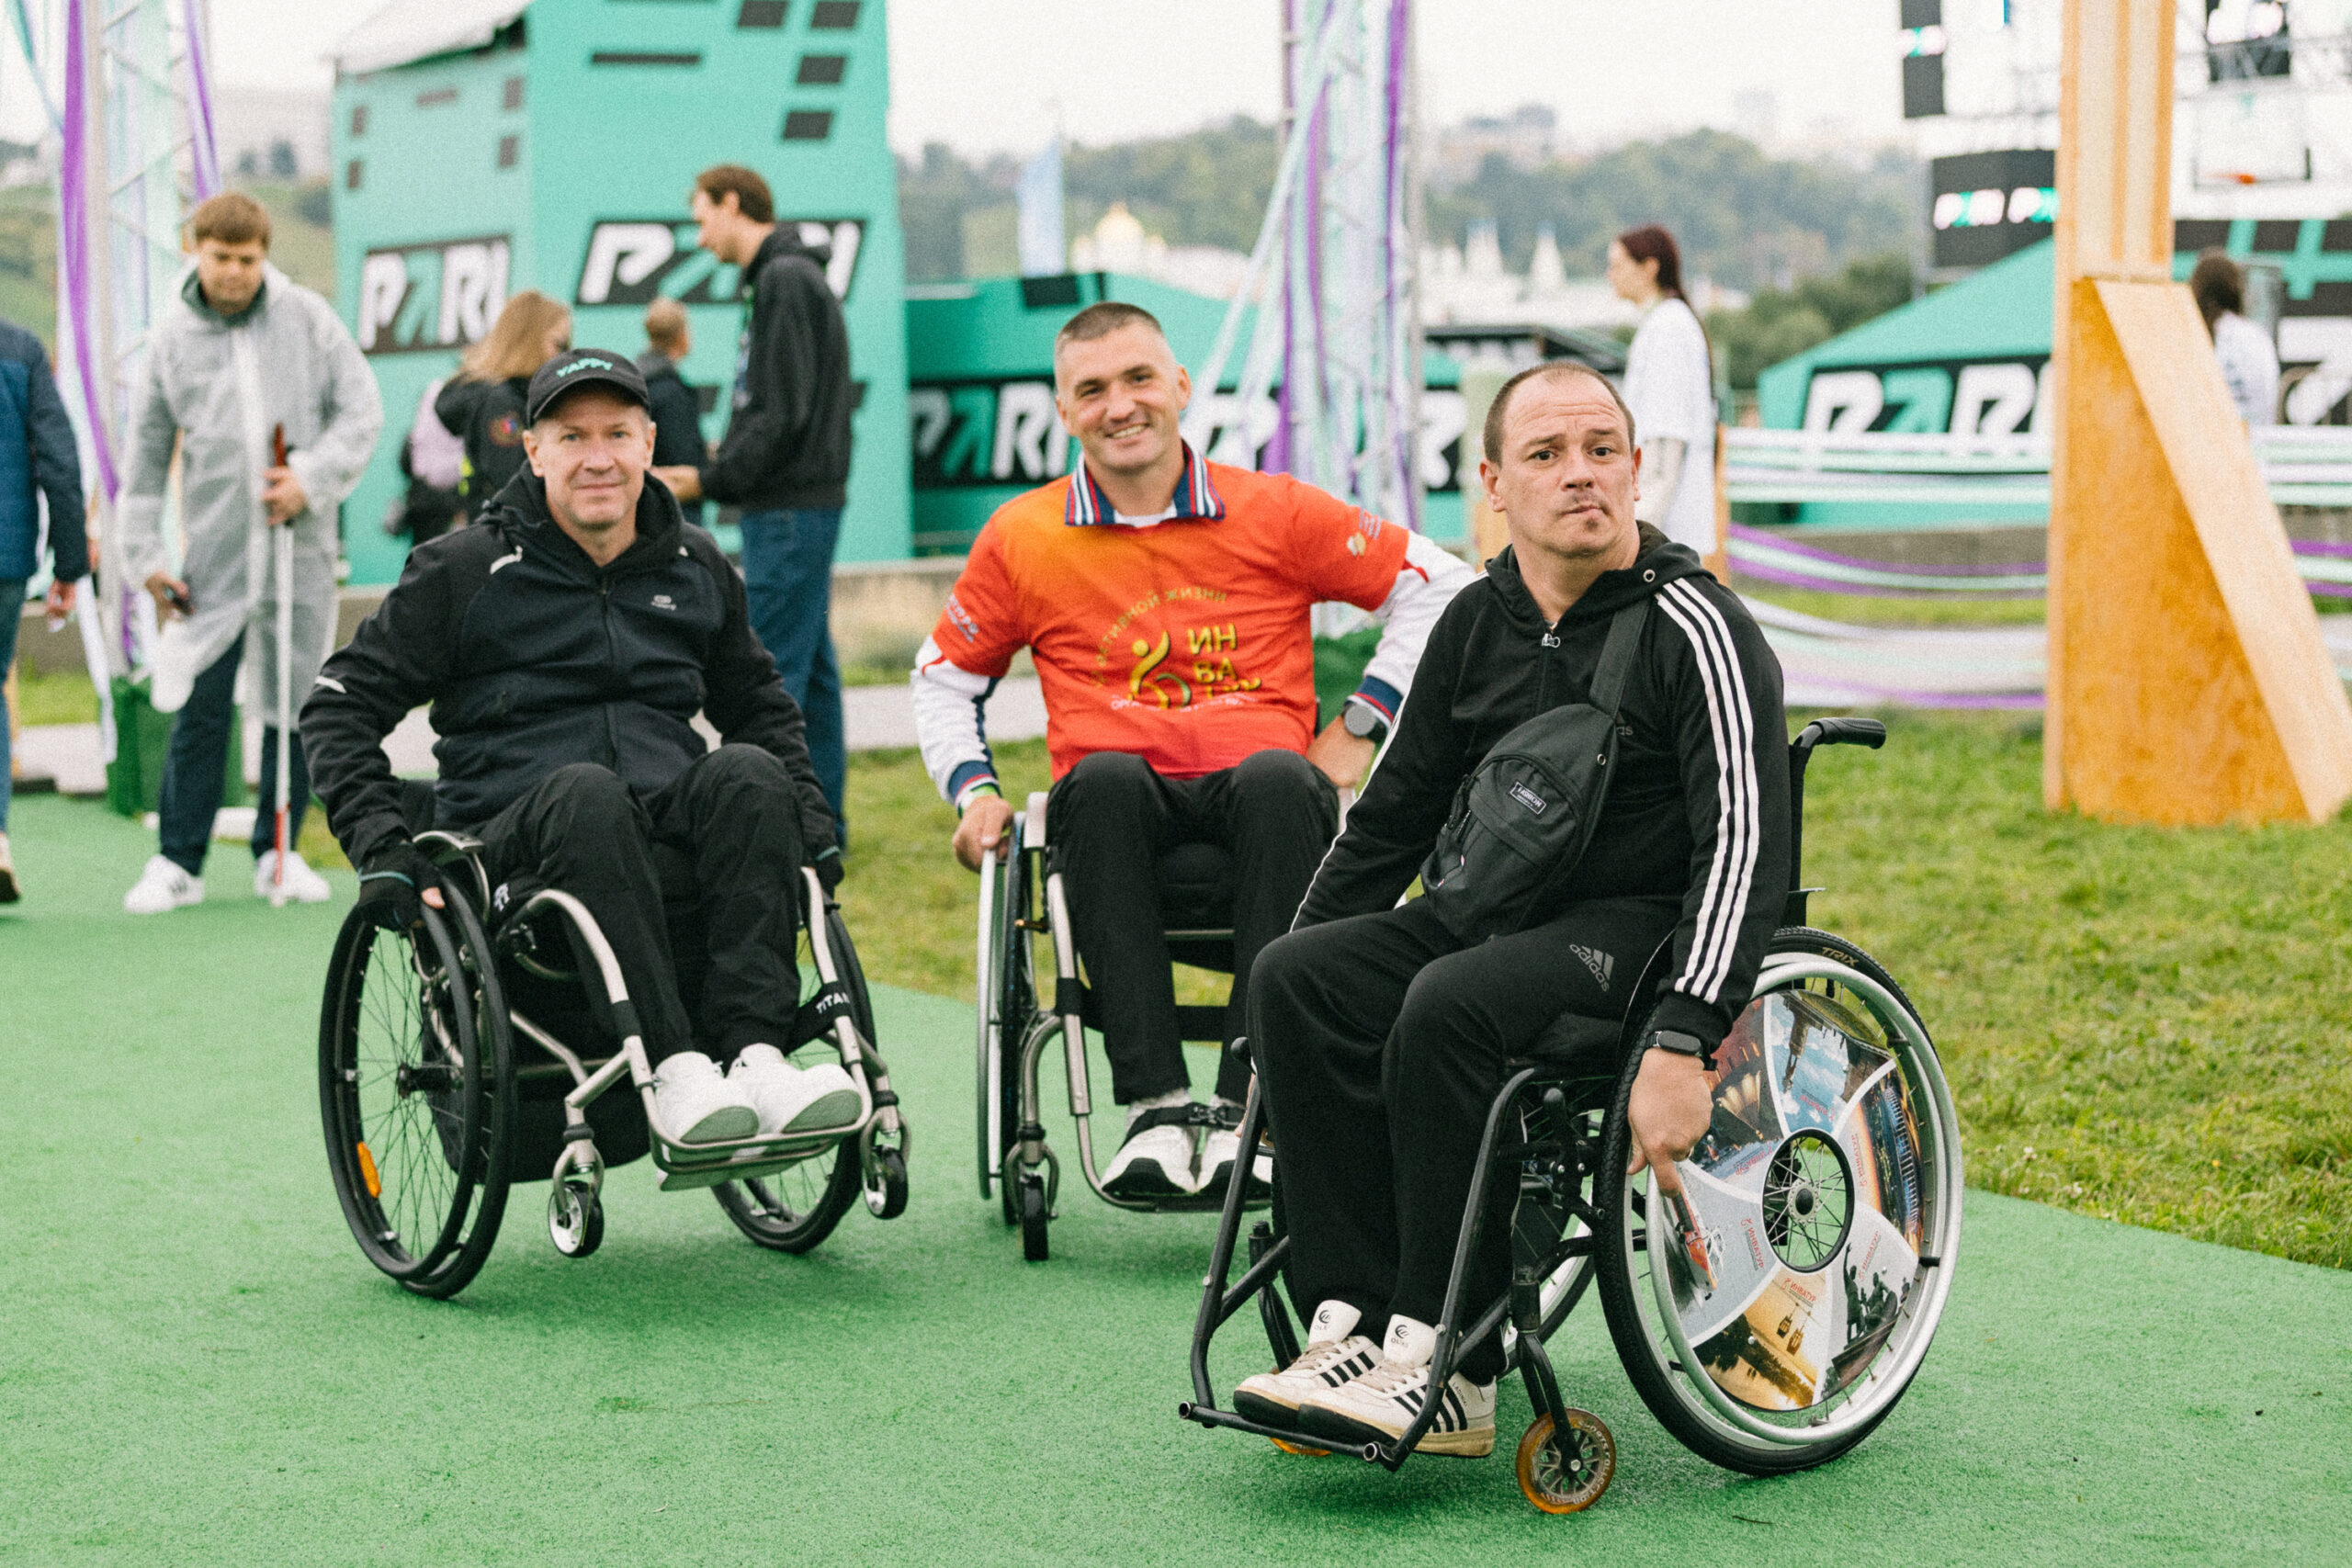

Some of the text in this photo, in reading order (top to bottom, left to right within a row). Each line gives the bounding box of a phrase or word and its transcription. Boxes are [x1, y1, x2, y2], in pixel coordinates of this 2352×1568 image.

[578, 222, 861, 304] PAI
[357, 239, 509, 351] PARI
[1188, 623, 1238, 655] ИН
[1194, 657, 1238, 684] ВА
[1569, 943, 1610, 992] adidas
[1822, 946, 1860, 967] TRIX
[1747, 1227, 1764, 1269] ИНВАТУР
[1790, 1281, 1816, 1303] ИНВАТУР
